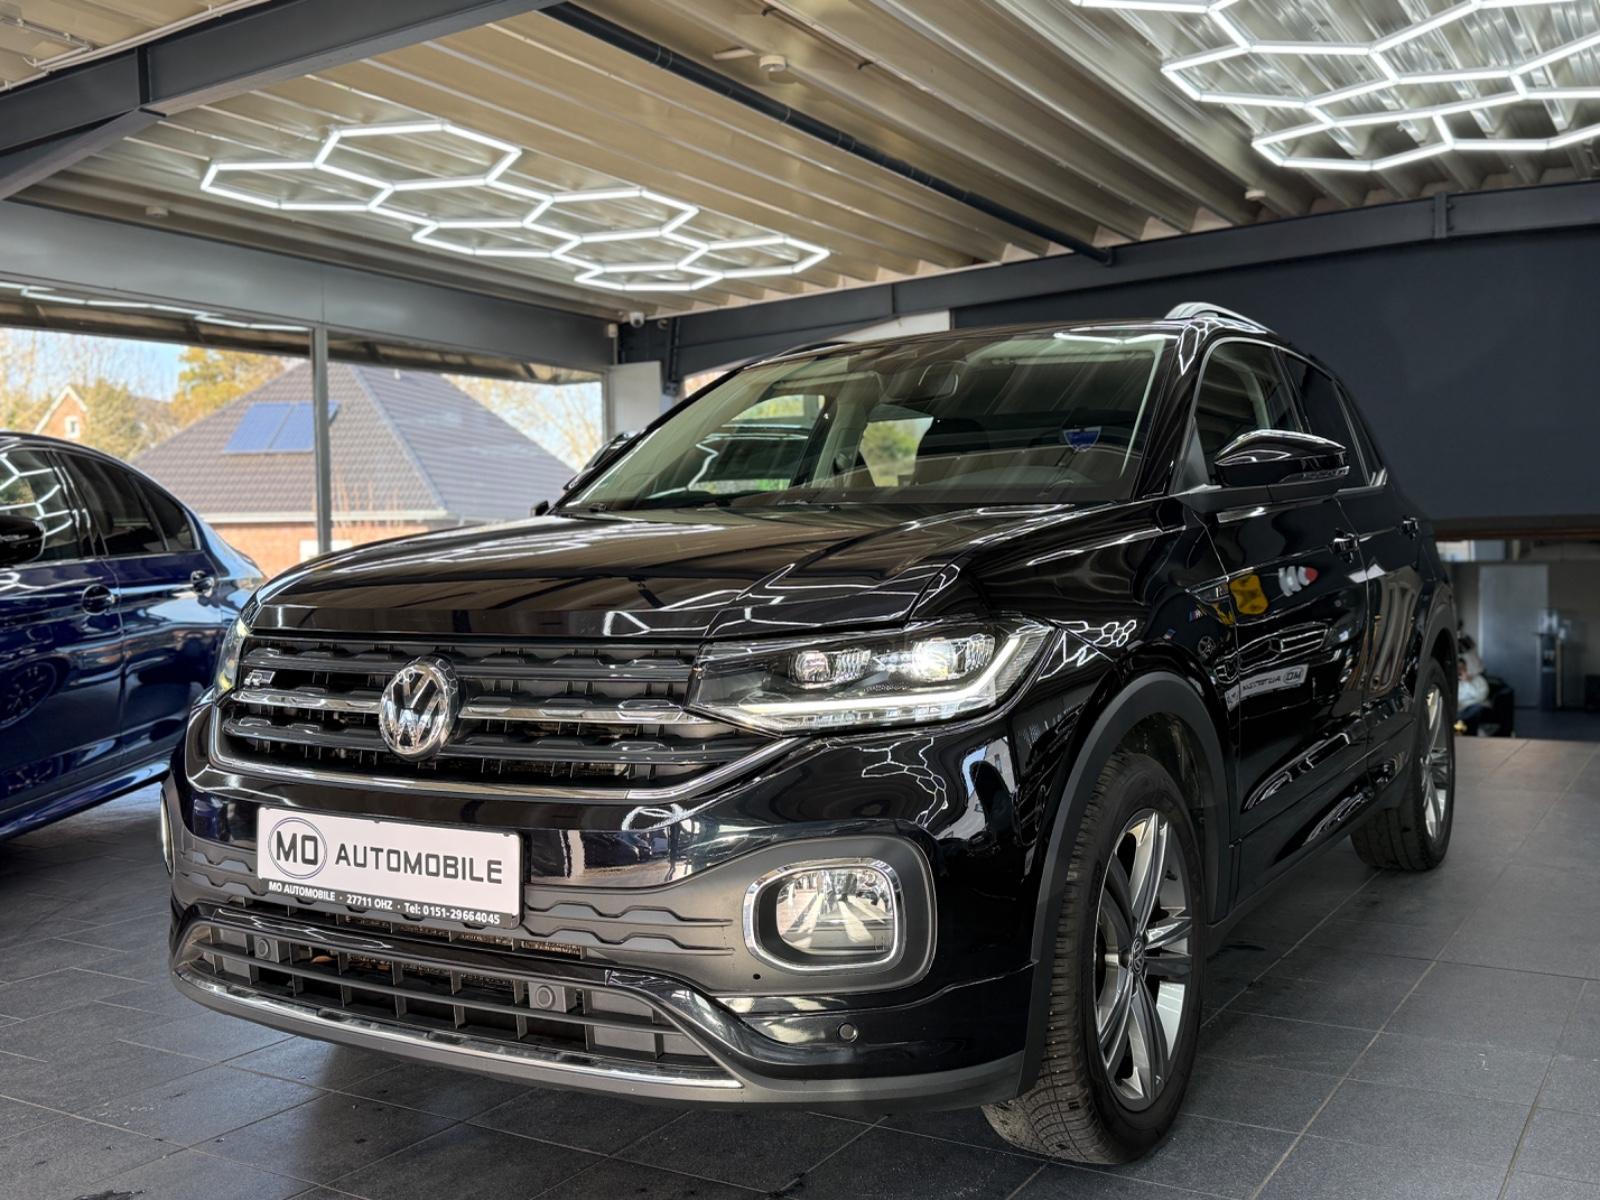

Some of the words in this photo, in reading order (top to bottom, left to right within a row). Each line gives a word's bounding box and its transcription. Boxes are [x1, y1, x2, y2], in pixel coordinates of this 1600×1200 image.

[276, 831, 318, 866] MO
[335, 843, 502, 884] AUTOMOBILE
[268, 880, 282, 892] MO
[283, 883, 336, 902] AUTOMOBILE
[346, 894, 372, 908] 27711
[374, 898, 393, 910] OHZ
[404, 902, 421, 915] Tel:
[422, 905, 501, 925] 0151-29664045
